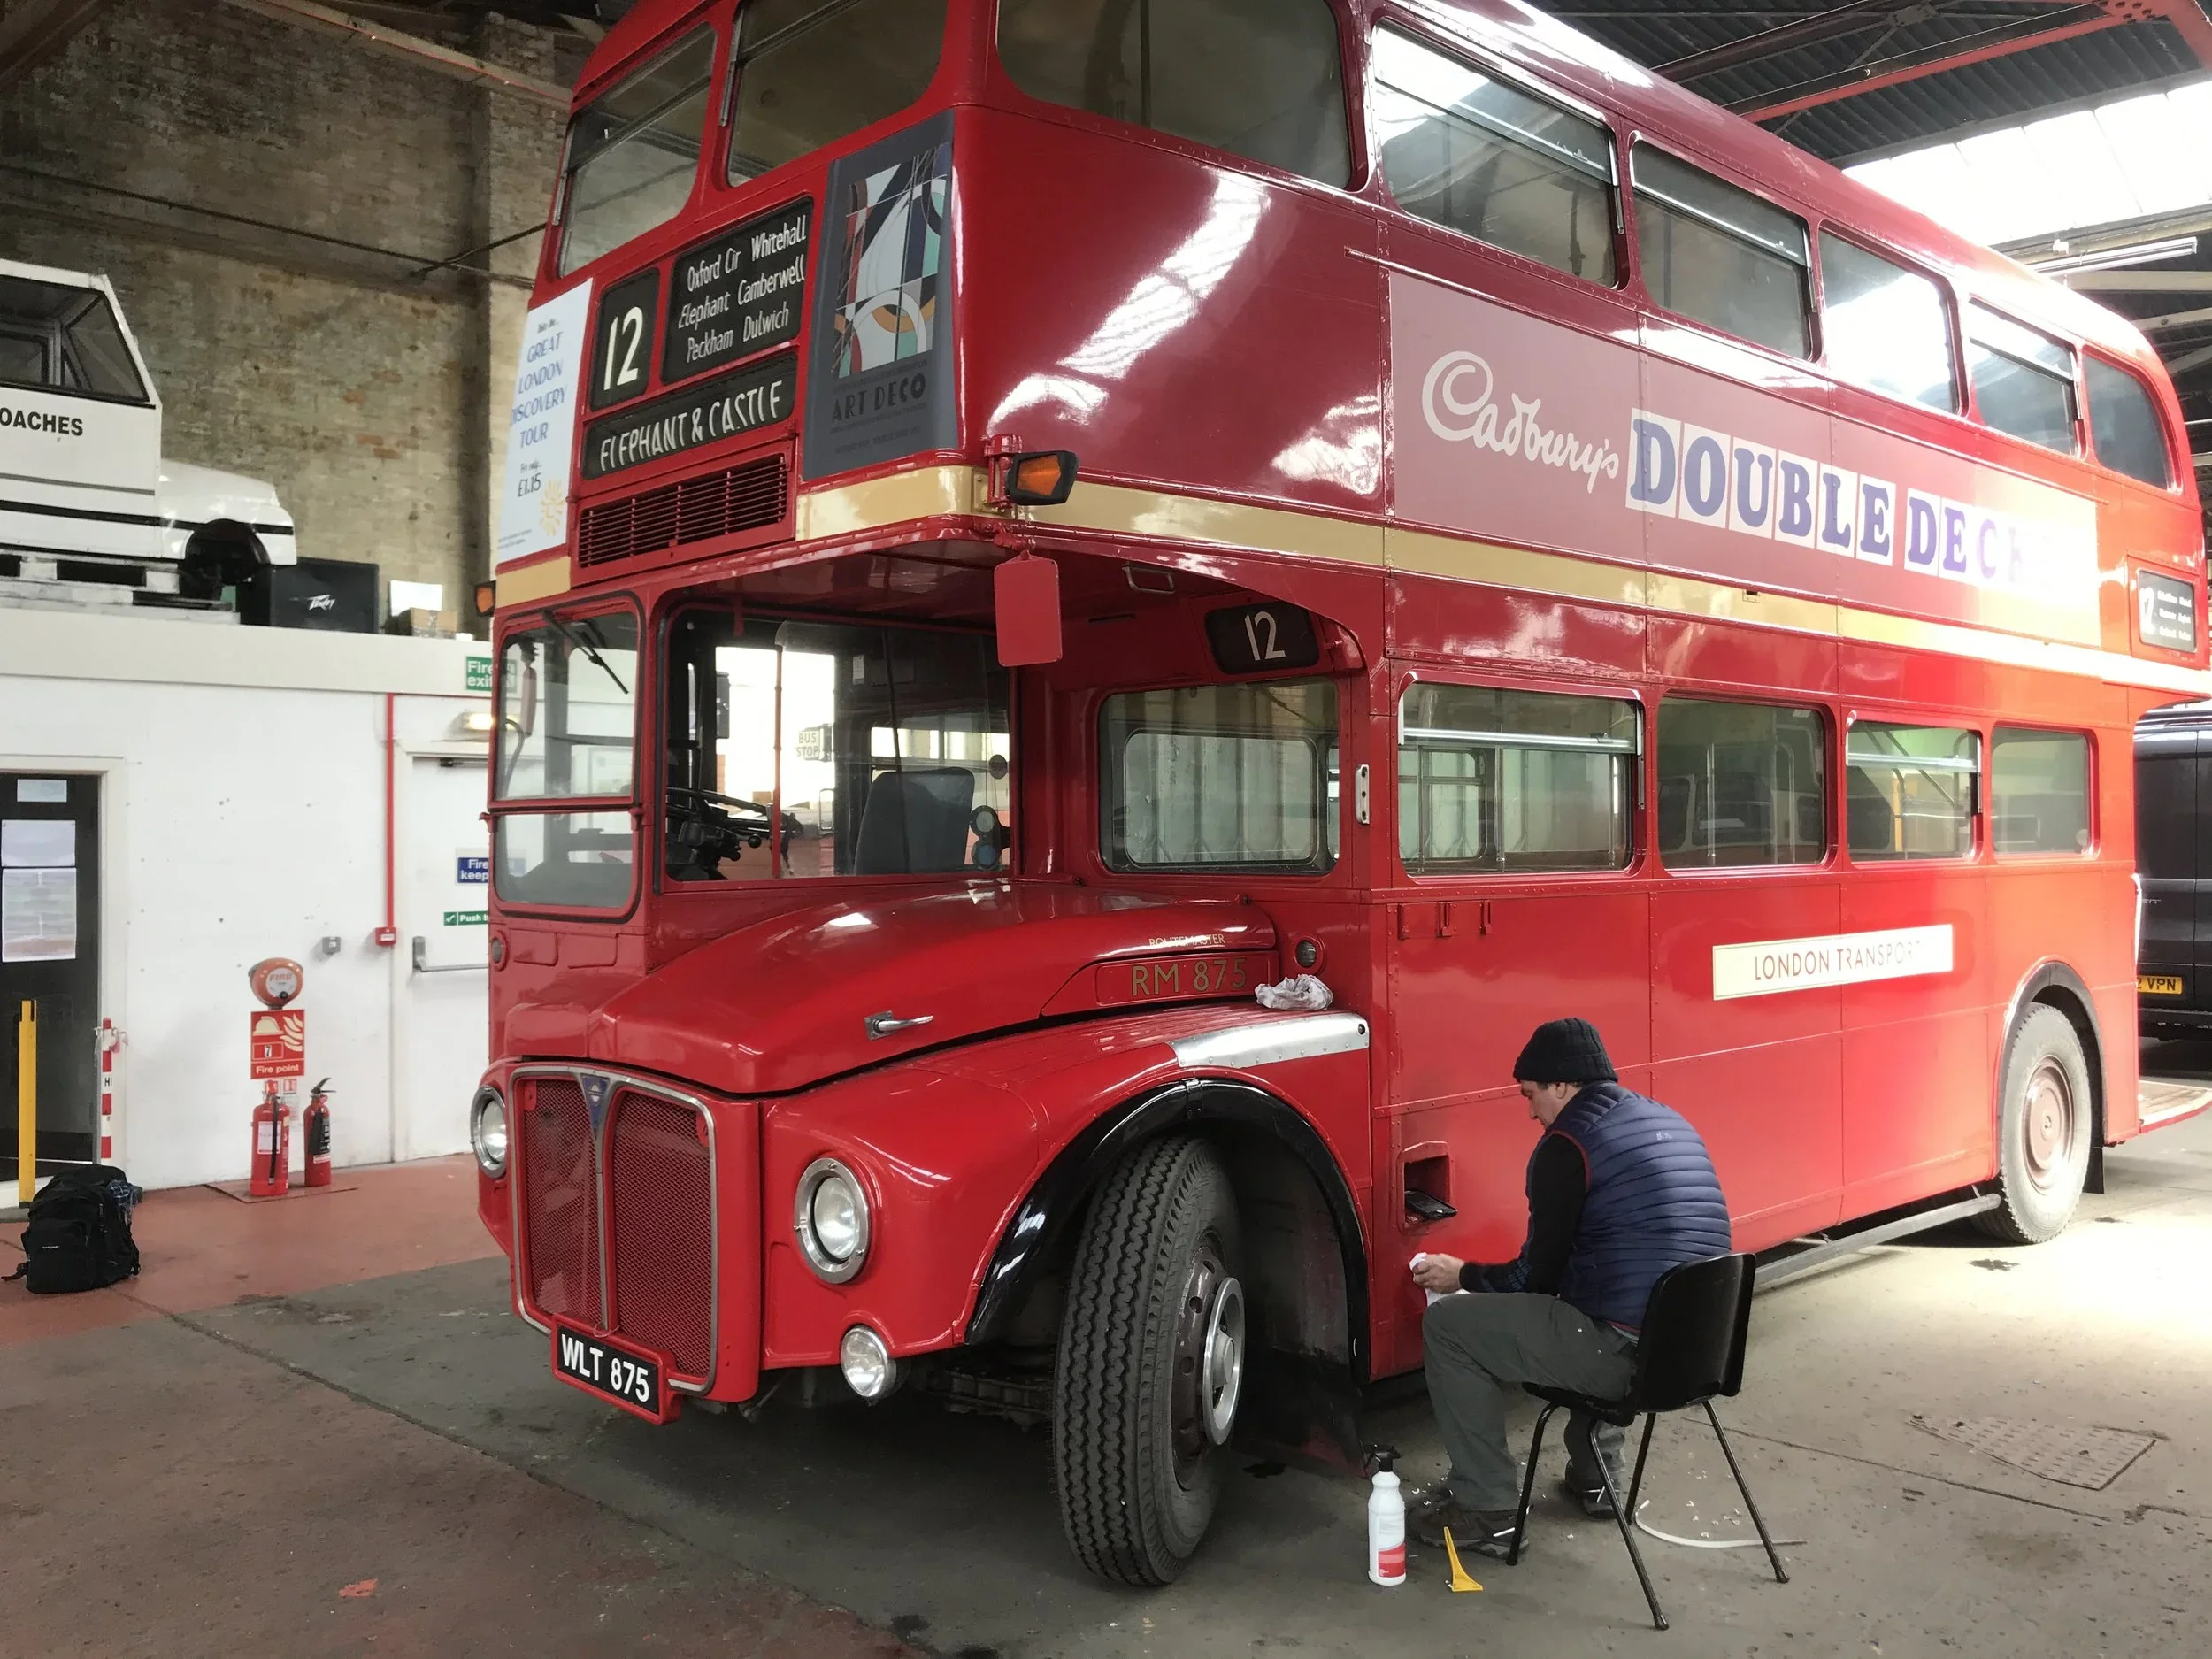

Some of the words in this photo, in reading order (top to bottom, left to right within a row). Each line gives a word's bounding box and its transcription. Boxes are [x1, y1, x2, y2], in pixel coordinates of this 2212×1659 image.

[687, 254, 721, 292] Oxford
[724, 247, 742, 273] Cir
[751, 214, 807, 261] Whitehall
[678, 291, 731, 331] Elephant
[737, 254, 805, 306] Camberwell
[526, 331, 563, 363] GREAT
[603, 306, 643, 391] 12
[686, 324, 734, 363] Peckham
[742, 302, 790, 342] Dulwich
[518, 359, 564, 395] LONDON
[832, 389, 868, 423] ART
[874, 373, 926, 411] DECO
[519, 422, 549, 449] TOUR
[691, 407, 703, 443] &
[1421, 350, 1620, 495] Cadbury's
[1629, 418, 1890, 557] DOUBLE
[1244, 611, 1286, 661] 12
[796, 745, 818, 757] STOP
[798, 733, 817, 744] BUS
[460, 870, 489, 882] keep
[468, 859, 489, 869] Fire
[459, 913, 482, 922] Push
[1132, 963, 1180, 996] RM
[1194, 957, 1247, 992] 875
[1754, 949, 1831, 980] LONDON
[2147, 978, 2176, 991] VPN
[255, 1065, 273, 1074] Fire
[276, 1064, 299, 1075] point
[561, 1333, 603, 1381] WLT
[611, 1357, 649, 1402] 875
